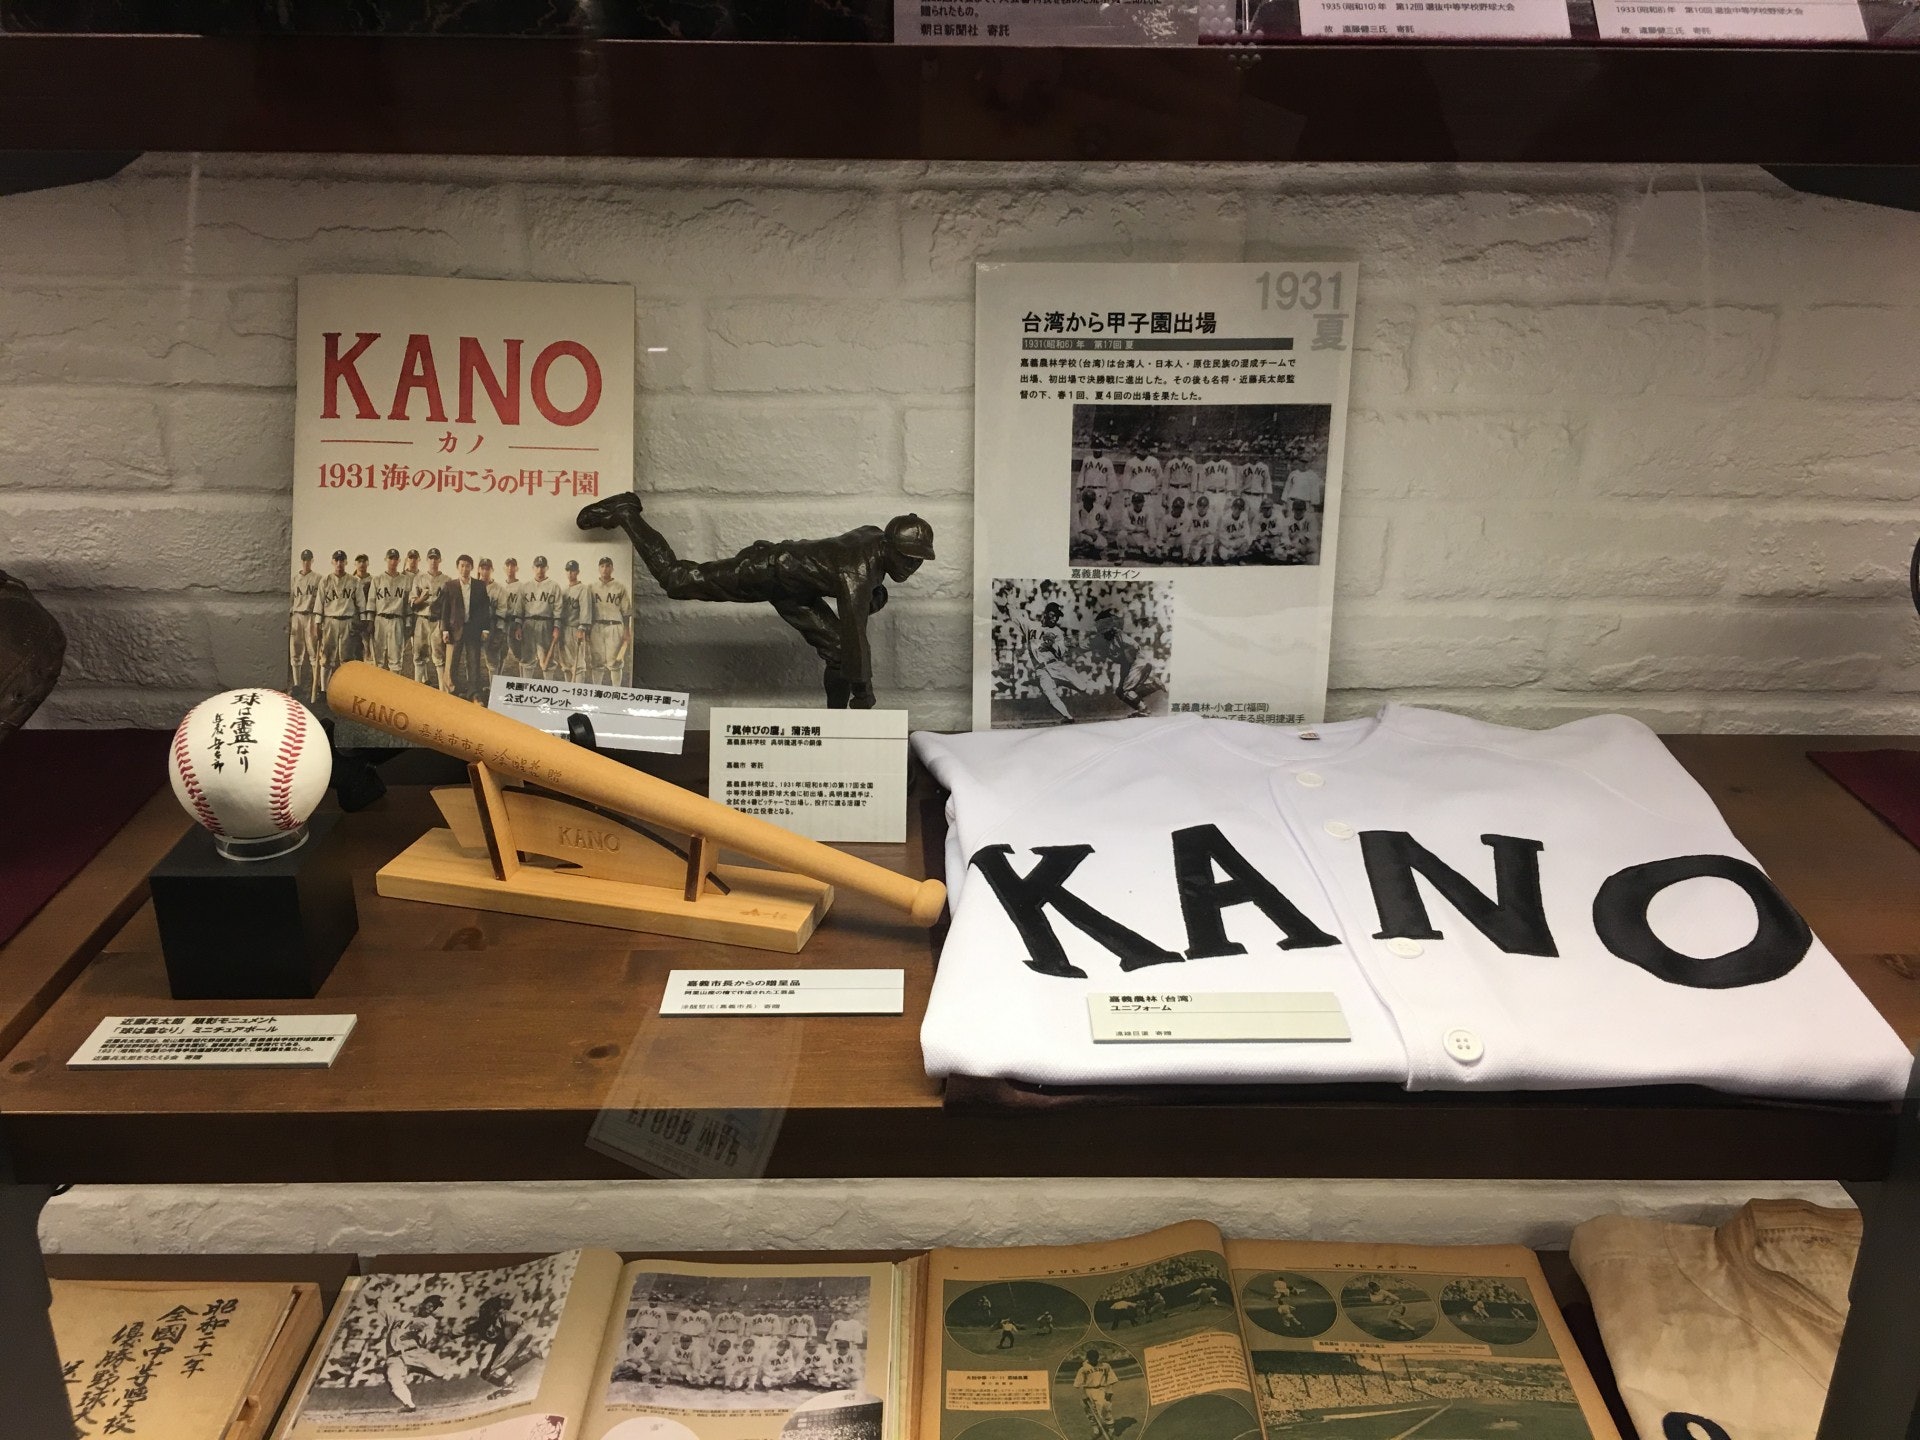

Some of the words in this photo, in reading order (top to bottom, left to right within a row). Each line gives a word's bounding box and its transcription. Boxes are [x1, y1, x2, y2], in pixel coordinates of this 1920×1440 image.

[920, 23, 979, 37] 朝日新聞社
[1256, 271, 1342, 311] 1931
[1021, 311, 1217, 335] 台湾から甲子園出場
[1311, 313, 1349, 351] 夏
[1094, 339, 1122, 350] 第17回
[1125, 340, 1134, 350] 夏
[320, 332, 602, 427] KANO
[438, 431, 484, 454] カノ
[317, 463, 600, 497] 1931海の向こうの甲子園
[1071, 568, 1140, 580] 嘉義農林ナイン
[352, 695, 409, 732] KANO
[557, 825, 621, 853] KANO
[968, 823, 1813, 990] KANO
[686, 979, 801, 987] 嘉義市長からの贈呈品
[1110, 1004, 1172, 1012] ユニフォーム
[72, 1321, 145, 1438] 優勝野球大
